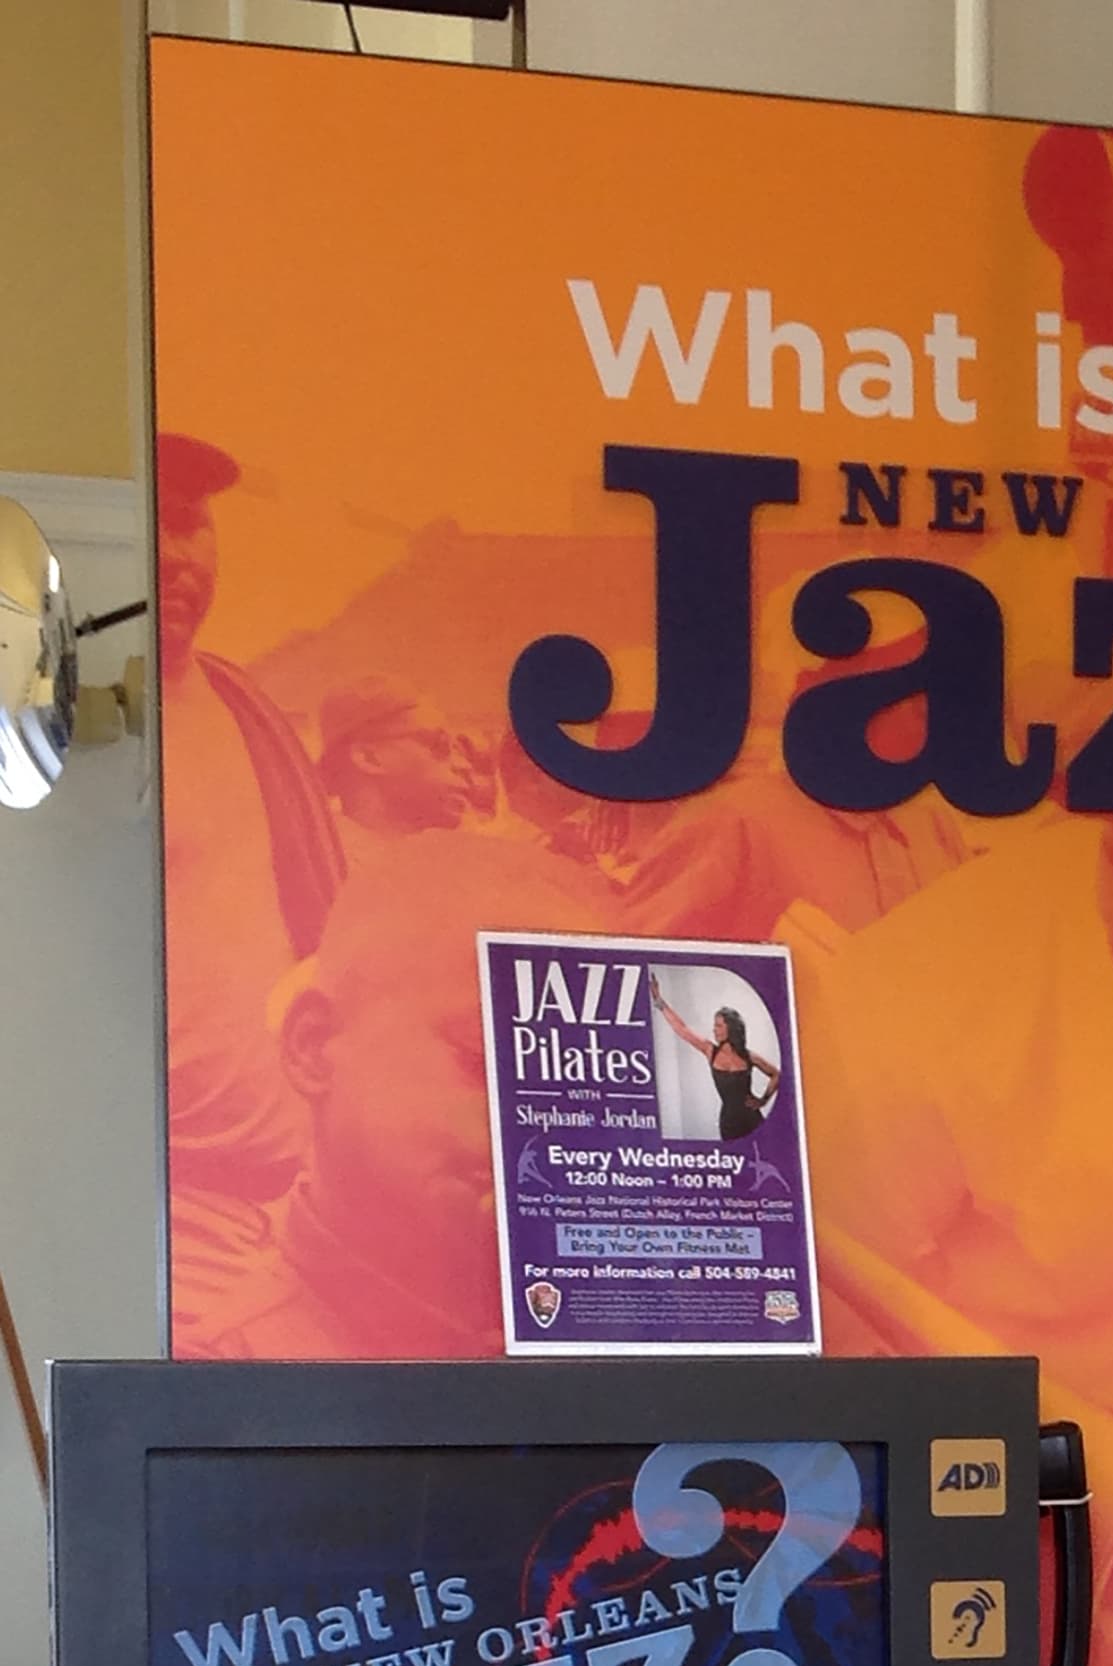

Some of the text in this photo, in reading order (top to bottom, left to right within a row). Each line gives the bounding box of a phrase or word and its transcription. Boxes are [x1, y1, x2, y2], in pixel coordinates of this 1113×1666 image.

[566, 277, 980, 426] What
[840, 461, 1084, 538] NEW
[512, 959, 646, 1027] JAZZ
[512, 1026, 652, 1084] Pilates
[567, 1089, 601, 1100] WITH
[516, 1104, 657, 1133] Stephanie Jordan
[548, 1145, 744, 1174] Every Wednesday
[565, 1171, 607, 1186] 12:00
[611, 1173, 653, 1187] Noon
[671, 1174, 703, 1188] 1:00
[707, 1175, 732, 1188] PM
[563, 1225, 593, 1238] Free
[596, 1226, 621, 1239] and
[625, 1227, 661, 1242] Open
[664, 1229, 678, 1240] to
[682, 1227, 703, 1240] the
[707, 1228, 743, 1240] Public
[571, 1240, 750, 1255] Bring Your Own Fitness Mat
[524, 1264, 547, 1278] For
[552, 1267, 589, 1278] more
[593, 1265, 674, 1280] information
[678, 1266, 701, 1280] call
[410, 1571, 475, 1631] is
[476, 1566, 746, 1663] ORLEANS
